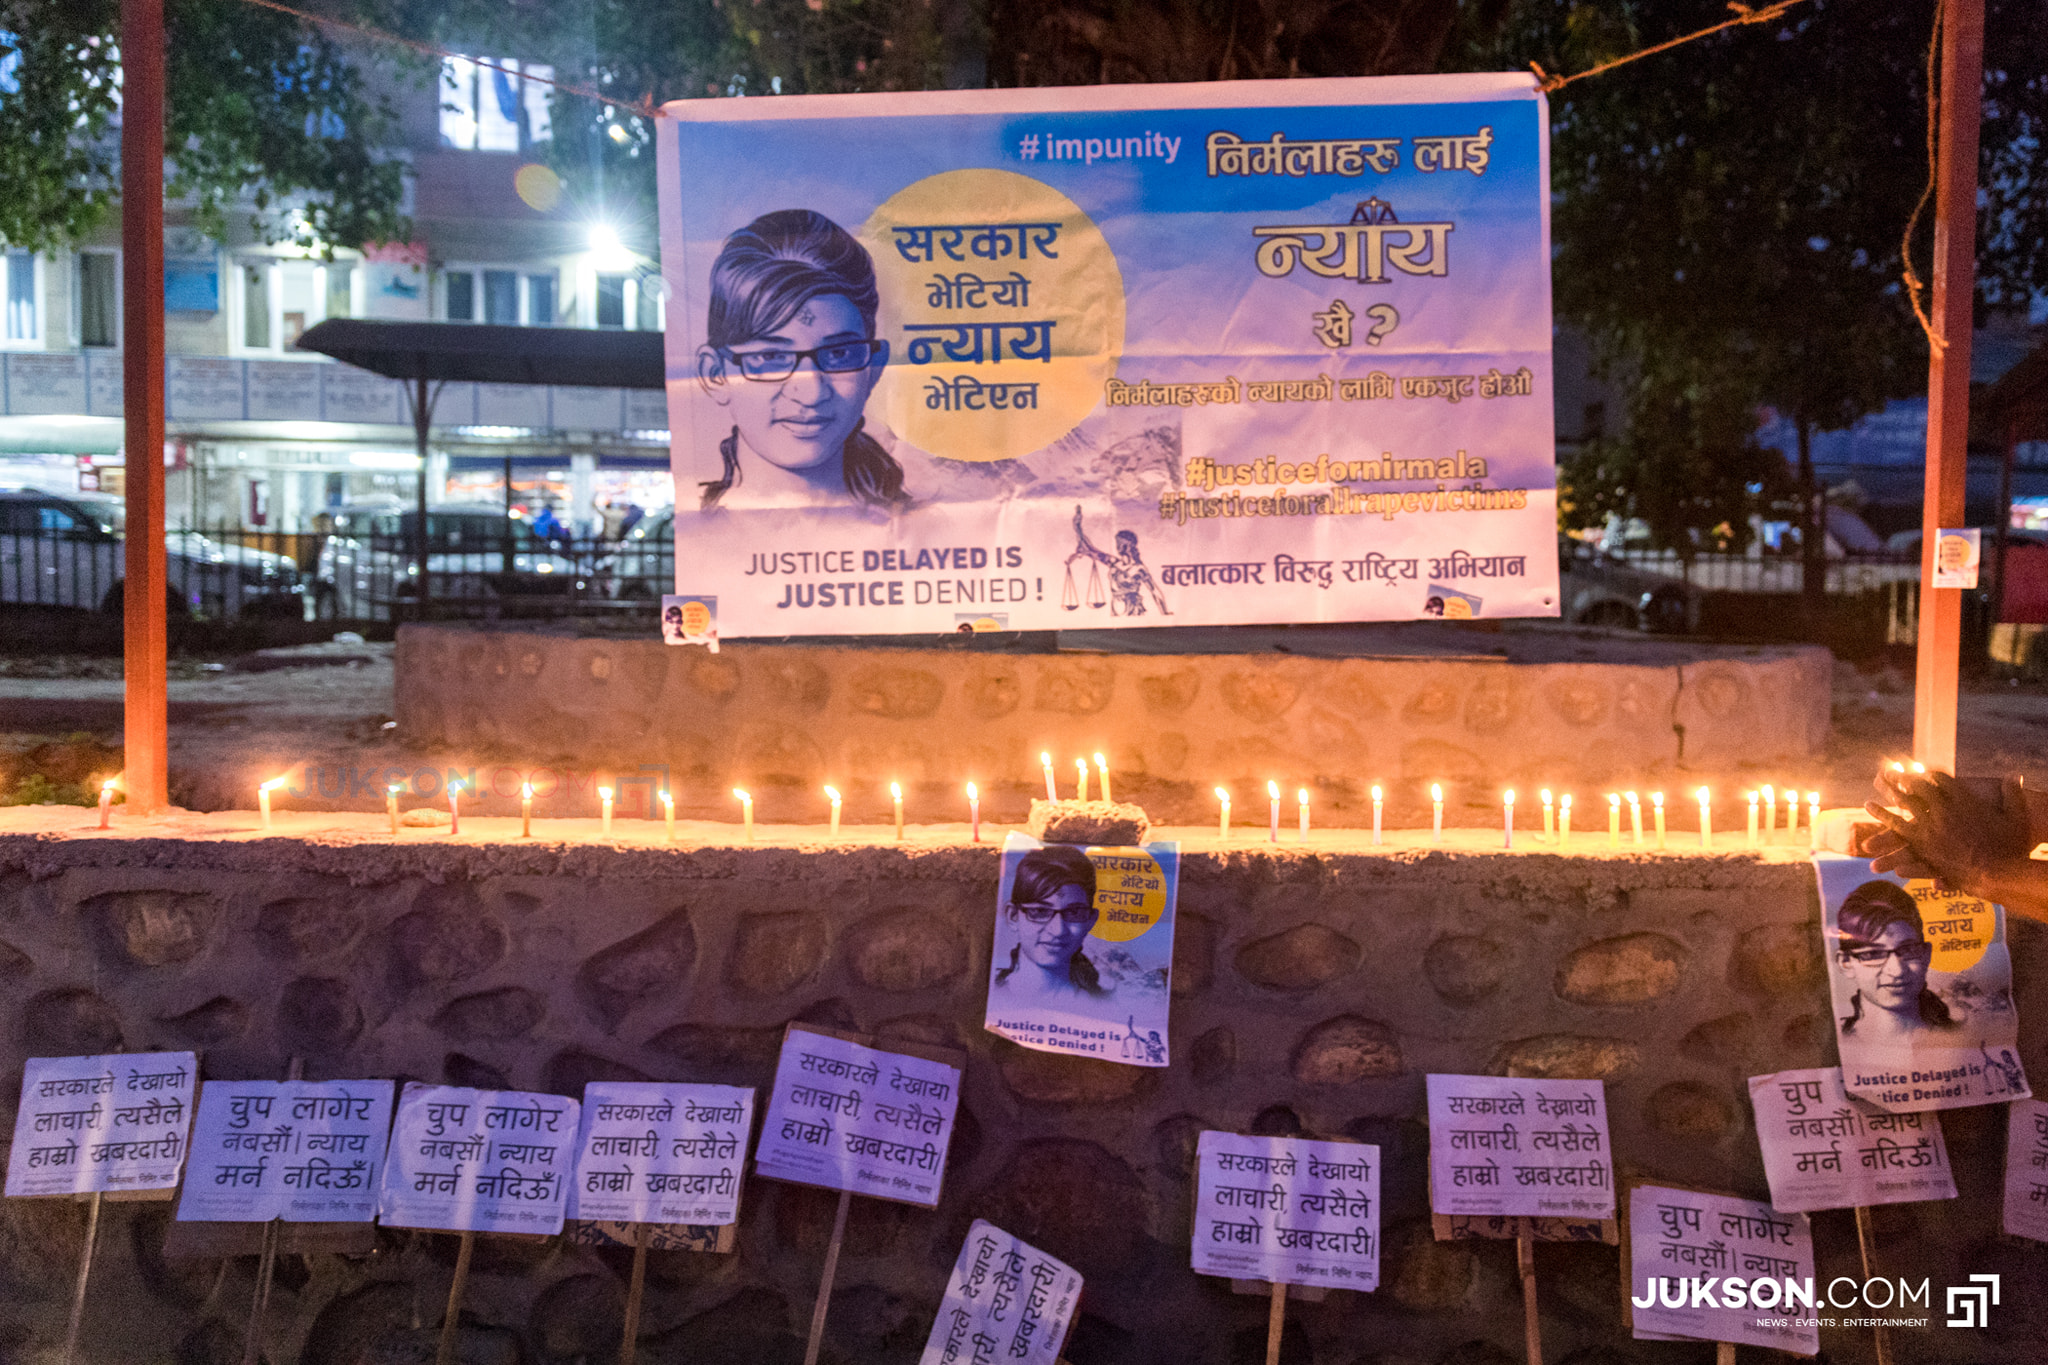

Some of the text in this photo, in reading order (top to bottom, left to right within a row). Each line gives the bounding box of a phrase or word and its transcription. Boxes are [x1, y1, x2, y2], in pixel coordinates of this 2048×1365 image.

[1412, 126, 1493, 177] लाई
[892, 222, 1062, 263] सरकार
[1253, 221, 1454, 284] न्याय
[925, 271, 1031, 309] भेटियो
[1312, 299, 1354, 349] खै
[903, 320, 1056, 366] न्याय
[923, 376, 1040, 411] भेटिएन
[1246, 373, 1335, 403] न्यायको
[1339, 370, 1395, 401] लागि
[1186, 449, 1488, 492] #justicefornirmala
[1160, 482, 1527, 526] #justiceforallrapevictims
[744, 546, 1022, 576] JUSTICE DELAYED IS
[1161, 563, 1266, 587] बलात्कार
[1342, 552, 1419, 587] राष्ट्रिय
[1428, 550, 1526, 579] अभियान
[777, 581, 904, 608] JUSTICE
[1090, 855, 1155, 873] सरकार
[1098, 889, 1144, 907] न्याय
[1926, 918, 1973, 935] न्याय
[996, 1019, 1122, 1042] Justice Delayed is
[39, 1066, 189, 1098] सरकारले देखायो
[800, 1052, 880, 1086] सरकारले
[1854, 1063, 1982, 1087] Justice Delayed is
[114, 1096, 184, 1126] त्यसैले
[228, 1087, 375, 1129] चुप लागेर
[597, 1098, 744, 1124] सरकारले देखायो
[1448, 1091, 1597, 1117] सरकारले देखायो
[1779, 1081, 1823, 1115] चुप
[426, 1099, 563, 1136] चुप लागेर
[780, 1117, 833, 1147] हाम्रो
[874, 1102, 946, 1136] त्यसैले
[1866, 1112, 1922, 1133] न्याय
[28, 1138, 79, 1168] हाम्रो
[307, 1134, 370, 1153] न्याय
[673, 1130, 739, 1160] त्यसैले
[1532, 1123, 1601, 1152] त्यसैले
[499, 1143, 557, 1165] न्याय
[1217, 1151, 1371, 1182] सरकारले देखायो
[1792, 1140, 1842, 1173] मर्न
[215, 1156, 269, 1188] मर्न
[414, 1163, 464, 1195] मर्न
[586, 1164, 634, 1193] हाम्रो
[1451, 1157, 1500, 1187] हाम्रो
[1300, 1187, 1372, 1219] त्यसैले
[1211, 1215, 1263, 1245] हाम्रो
[1657, 1204, 1794, 1246] चुप लागेर
[1742, 1253, 1799, 1281] न्याय
